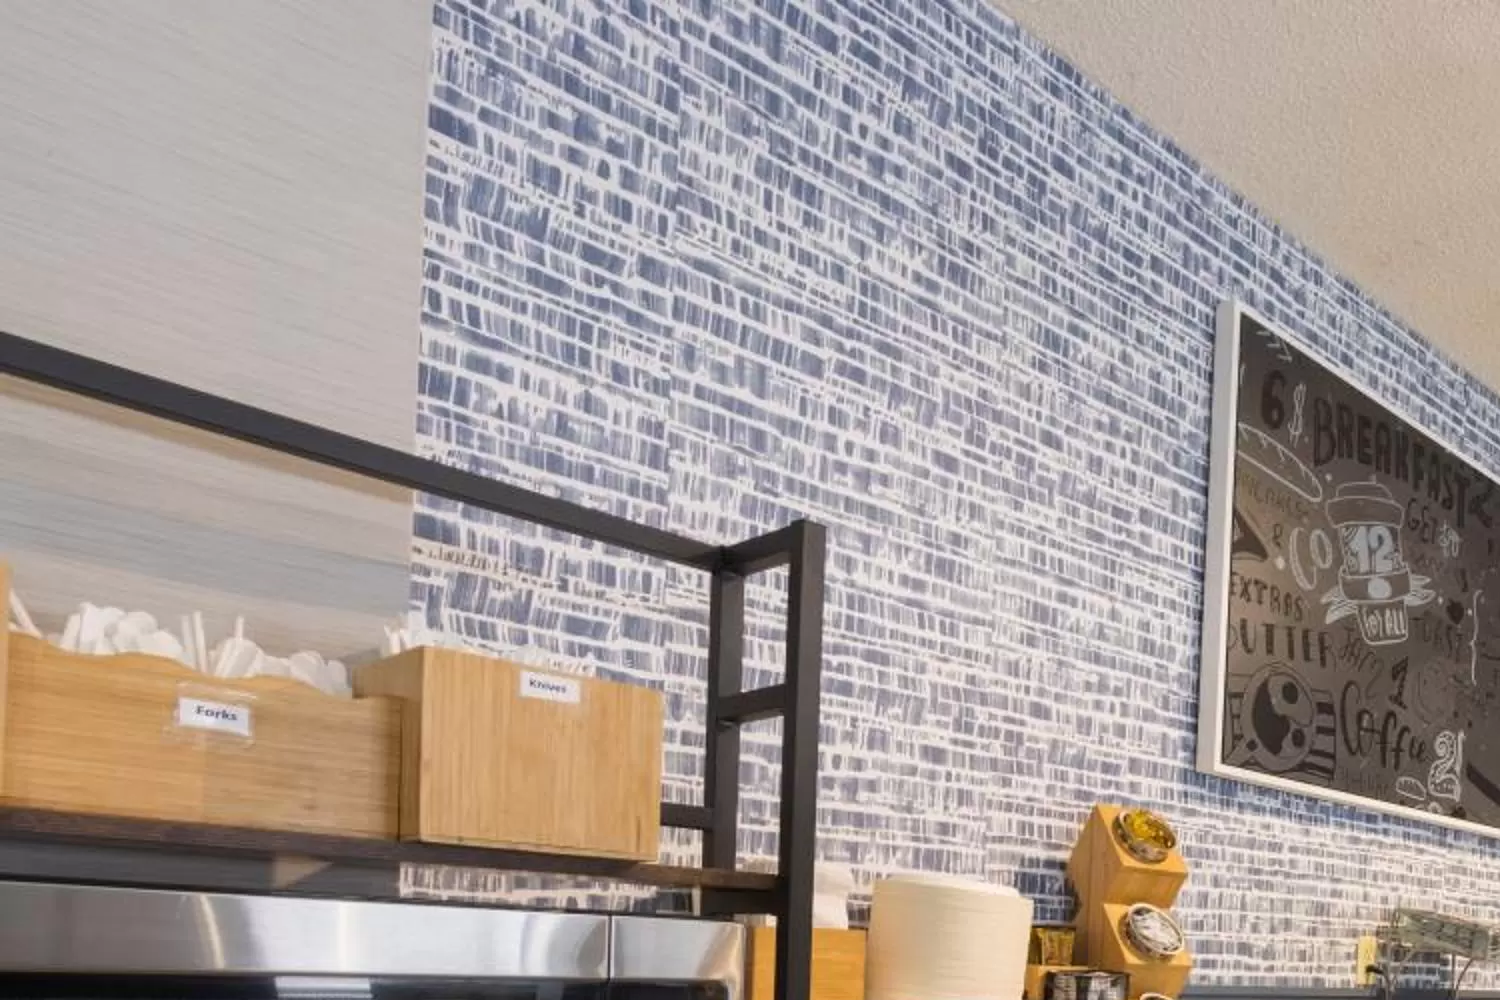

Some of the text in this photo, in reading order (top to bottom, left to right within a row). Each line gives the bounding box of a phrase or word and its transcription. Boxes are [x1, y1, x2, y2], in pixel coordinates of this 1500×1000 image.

[1259, 369, 1286, 430] 6
[1313, 396, 1470, 529] BREAKFAST
[1349, 525, 1395, 574] 12
[194, 704, 239, 721] Forks
[1340, 680, 1428, 772] Coffee
